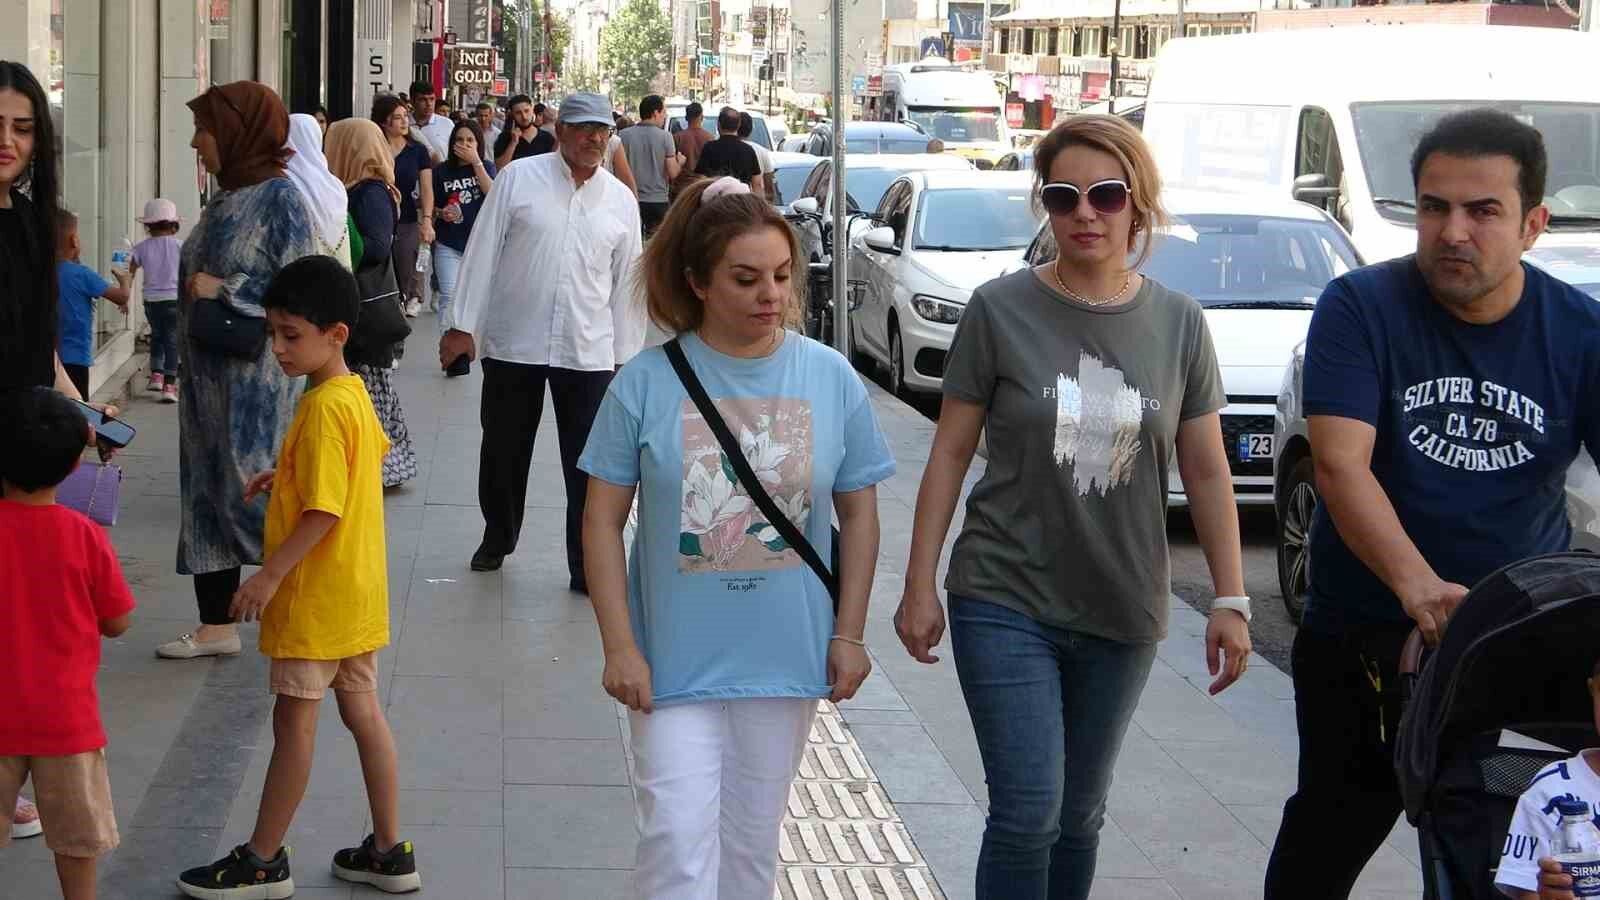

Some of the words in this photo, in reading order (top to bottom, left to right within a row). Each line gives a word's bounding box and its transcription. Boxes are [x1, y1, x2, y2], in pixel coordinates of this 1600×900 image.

[454, 69, 492, 84] GOLD
[1403, 376, 1474, 413] SILVER
[1480, 379, 1545, 434] STATE
[1445, 412, 1468, 438] CA
[1472, 417, 1498, 442] 78
[1251, 436, 1272, 456] 23
[1408, 424, 1535, 472] CALIFORNIA
